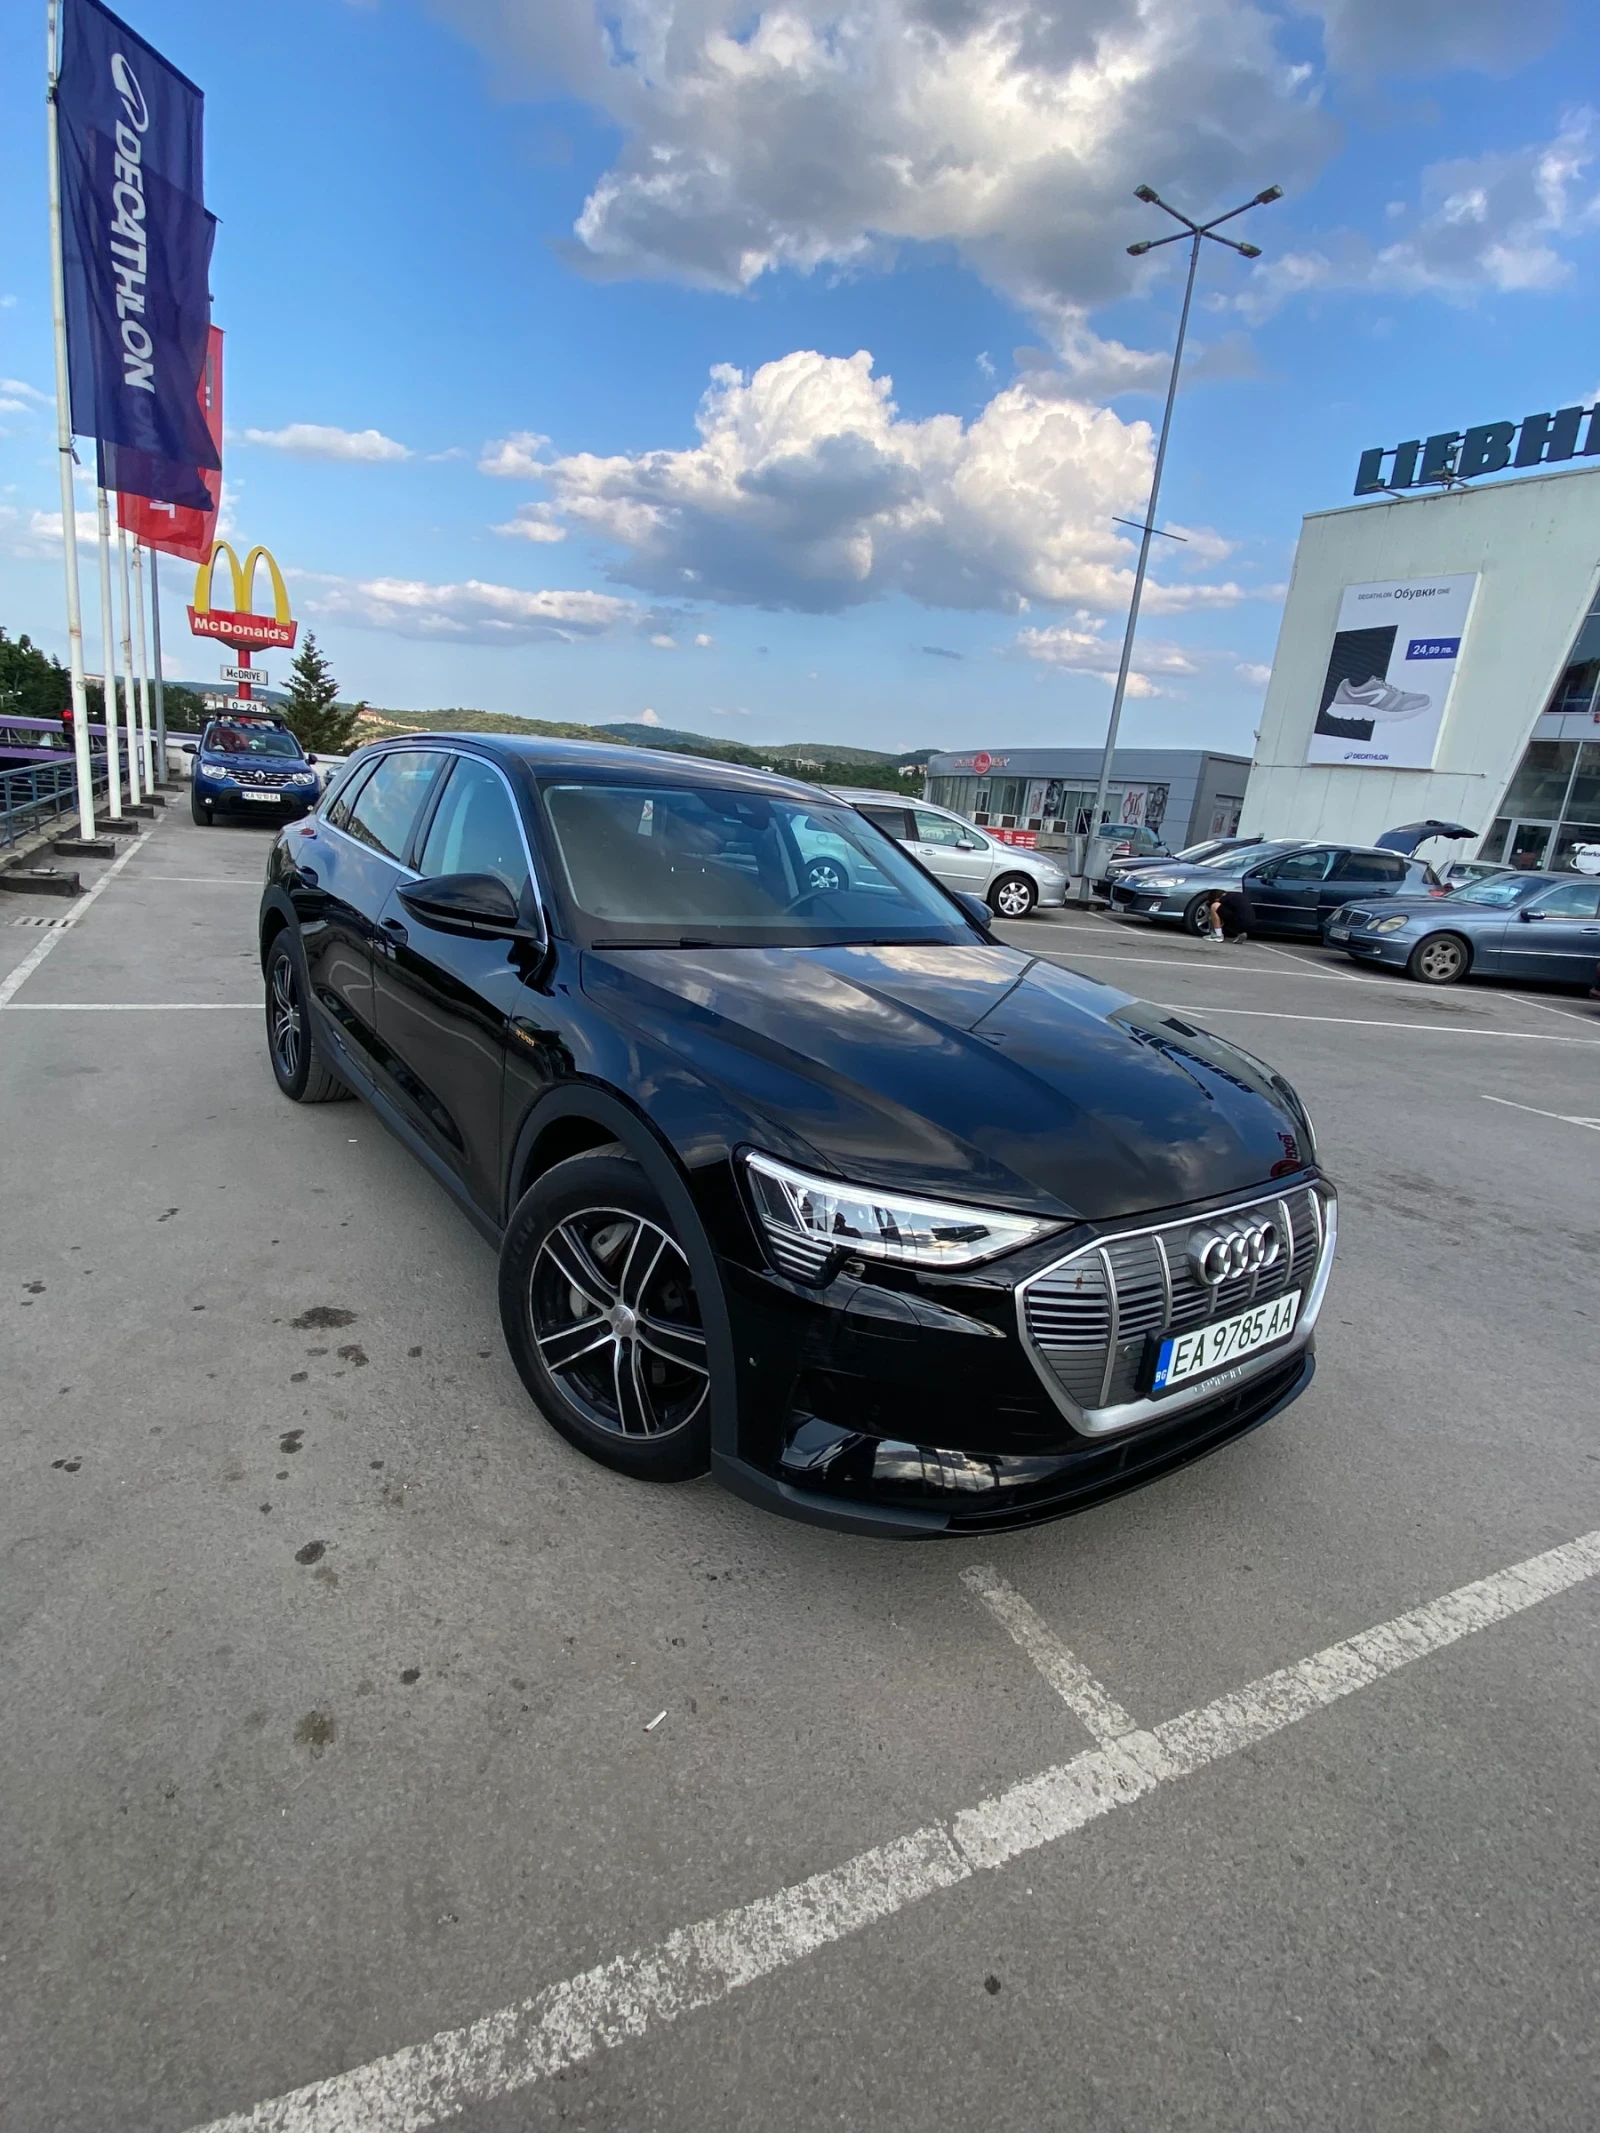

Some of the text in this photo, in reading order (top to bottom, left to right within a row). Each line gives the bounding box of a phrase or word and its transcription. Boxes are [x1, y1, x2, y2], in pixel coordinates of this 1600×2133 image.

[111, 118, 156, 394] DECATHLON
[1393, 587, 1437, 601] Обувки
[193, 617, 290, 641] McDonald's
[1412, 645, 1453, 656] 24,99 лв.
[226, 668, 261, 681] McDRIVE
[1172, 1298, 1293, 1378] EA 9785 AA
[1155, 1369, 1168, 1383] BG
